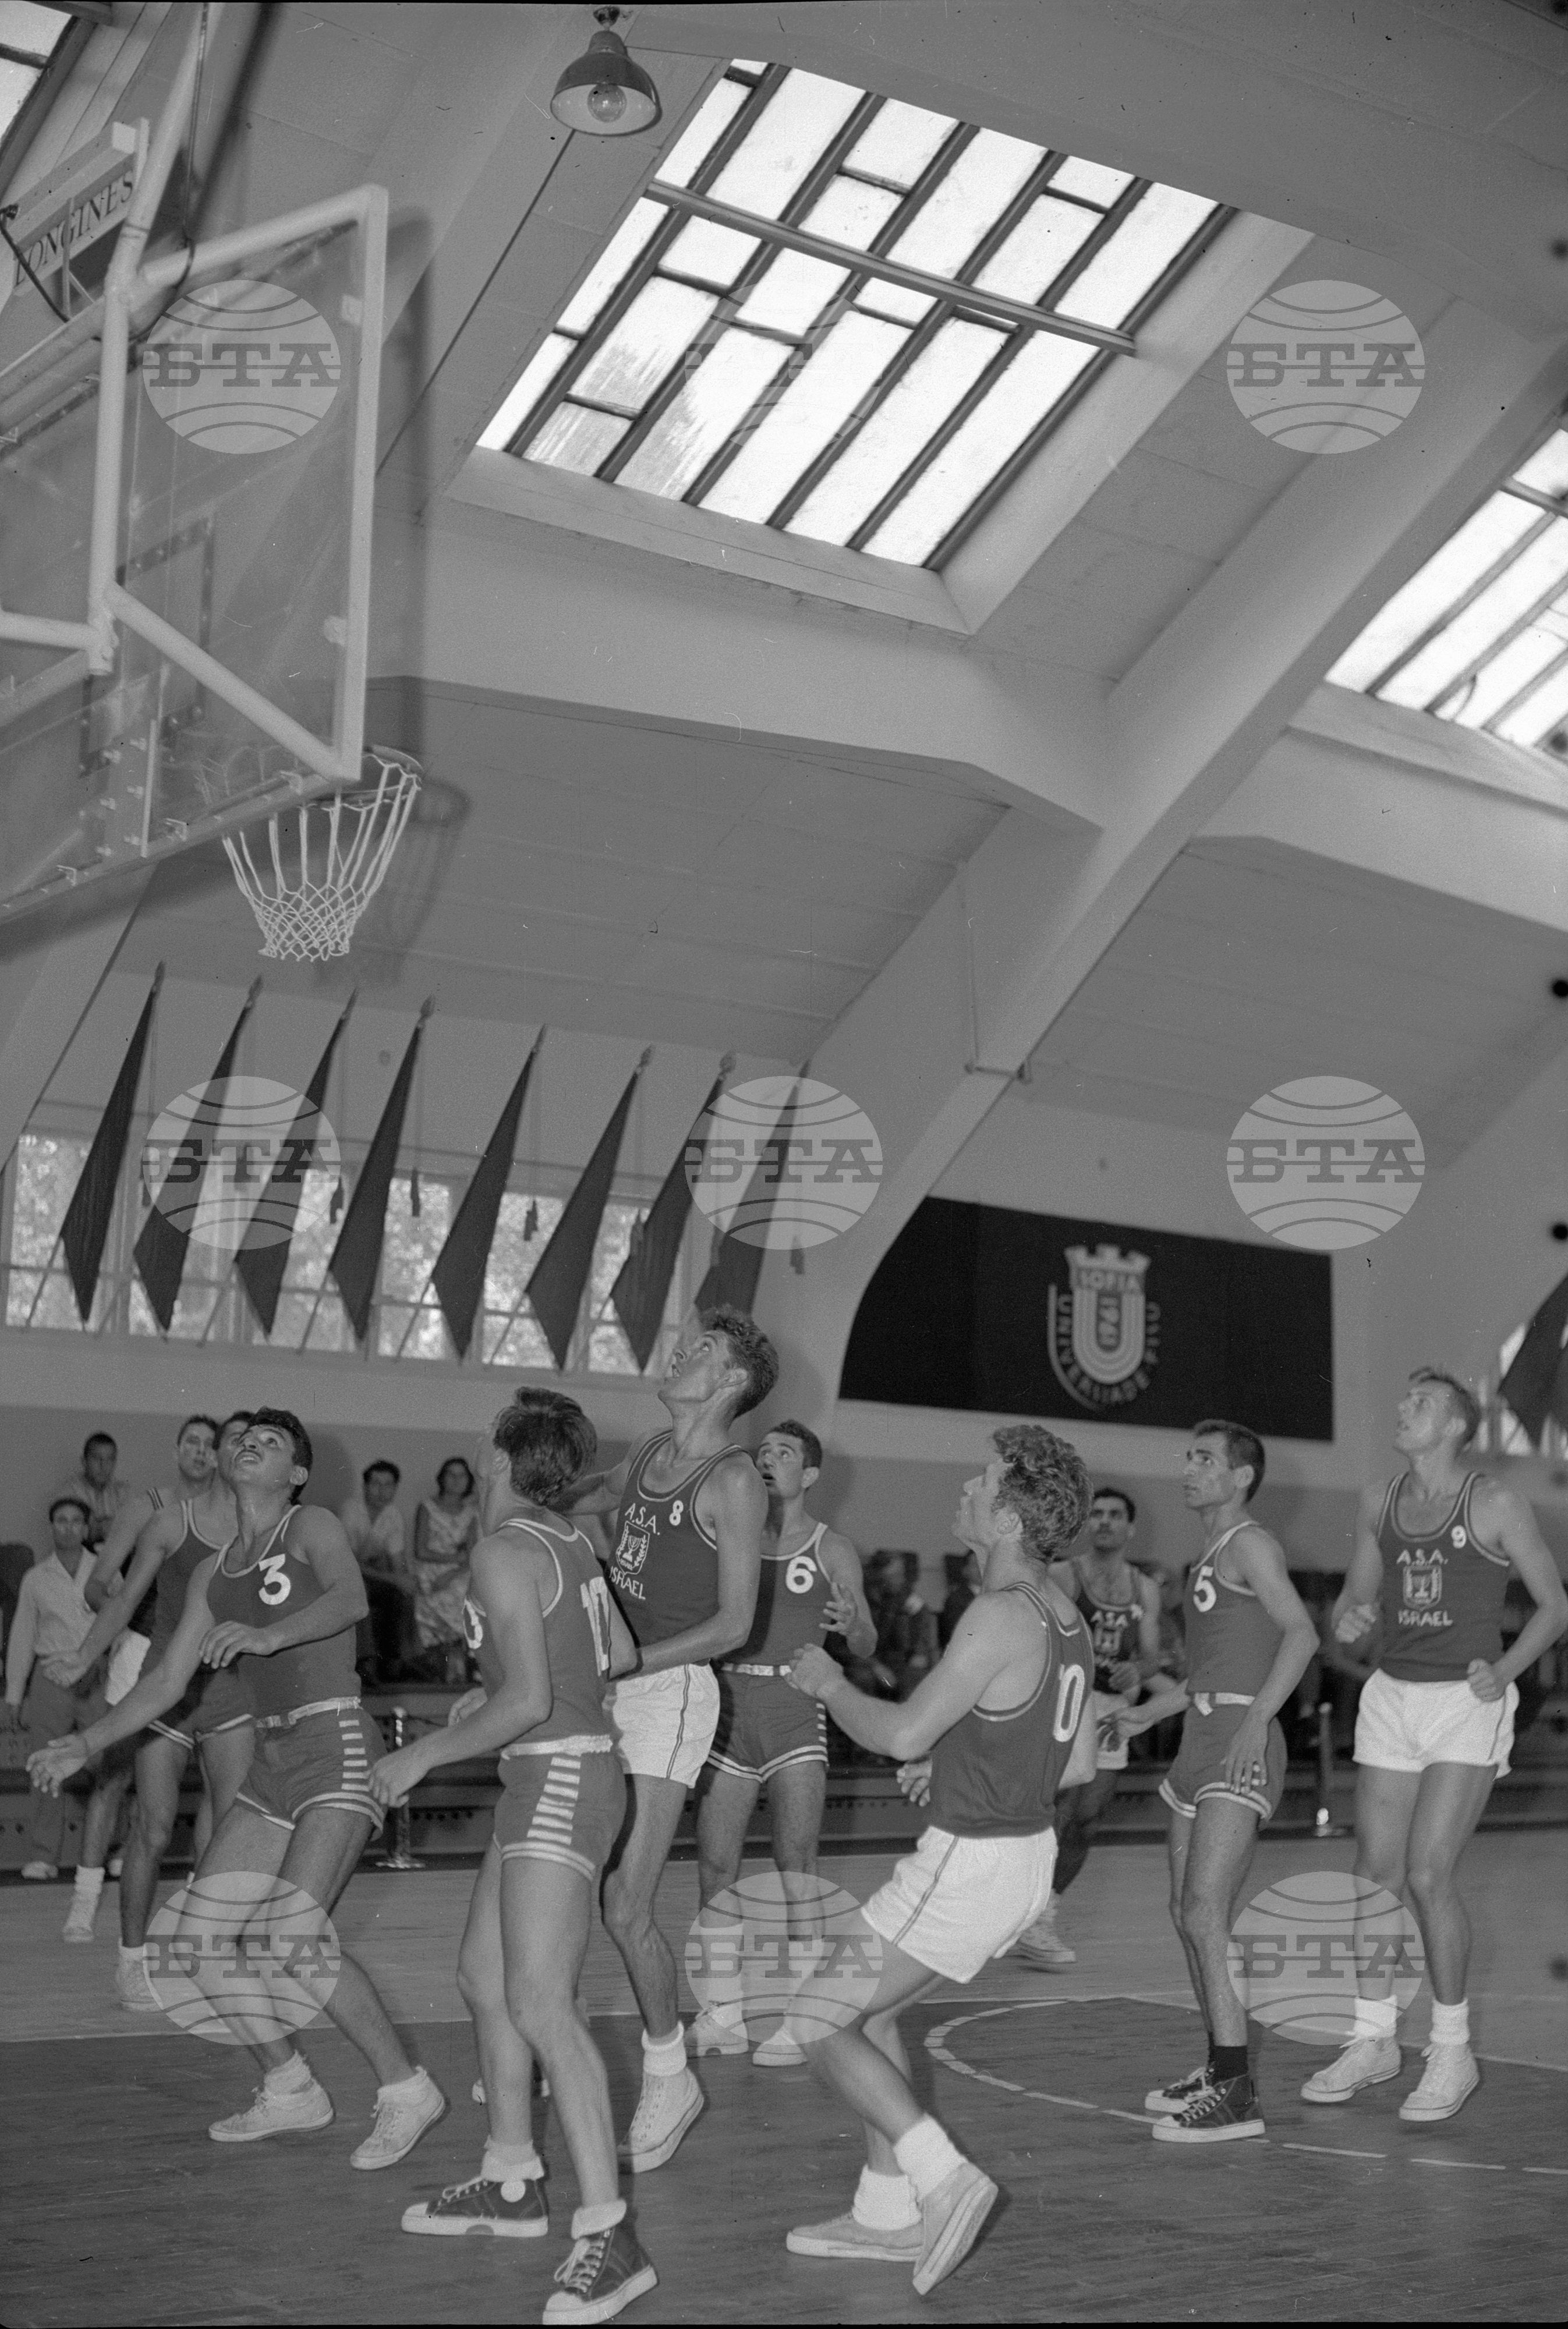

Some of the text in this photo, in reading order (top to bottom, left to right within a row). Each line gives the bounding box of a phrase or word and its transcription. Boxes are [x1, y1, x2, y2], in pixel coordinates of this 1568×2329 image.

[625, 1503, 660, 1536] A.S.A.
[670, 1500, 684, 1526] 8
[1451, 1524, 1467, 1549] 9
[259, 1553, 291, 1605] 3
[609, 1566, 646, 1600] ISRAEL
[785, 1556, 816, 1594] 6
[1193, 1566, 1216, 1612] 5
[1398, 1609, 1453, 1627] ISRAEL
